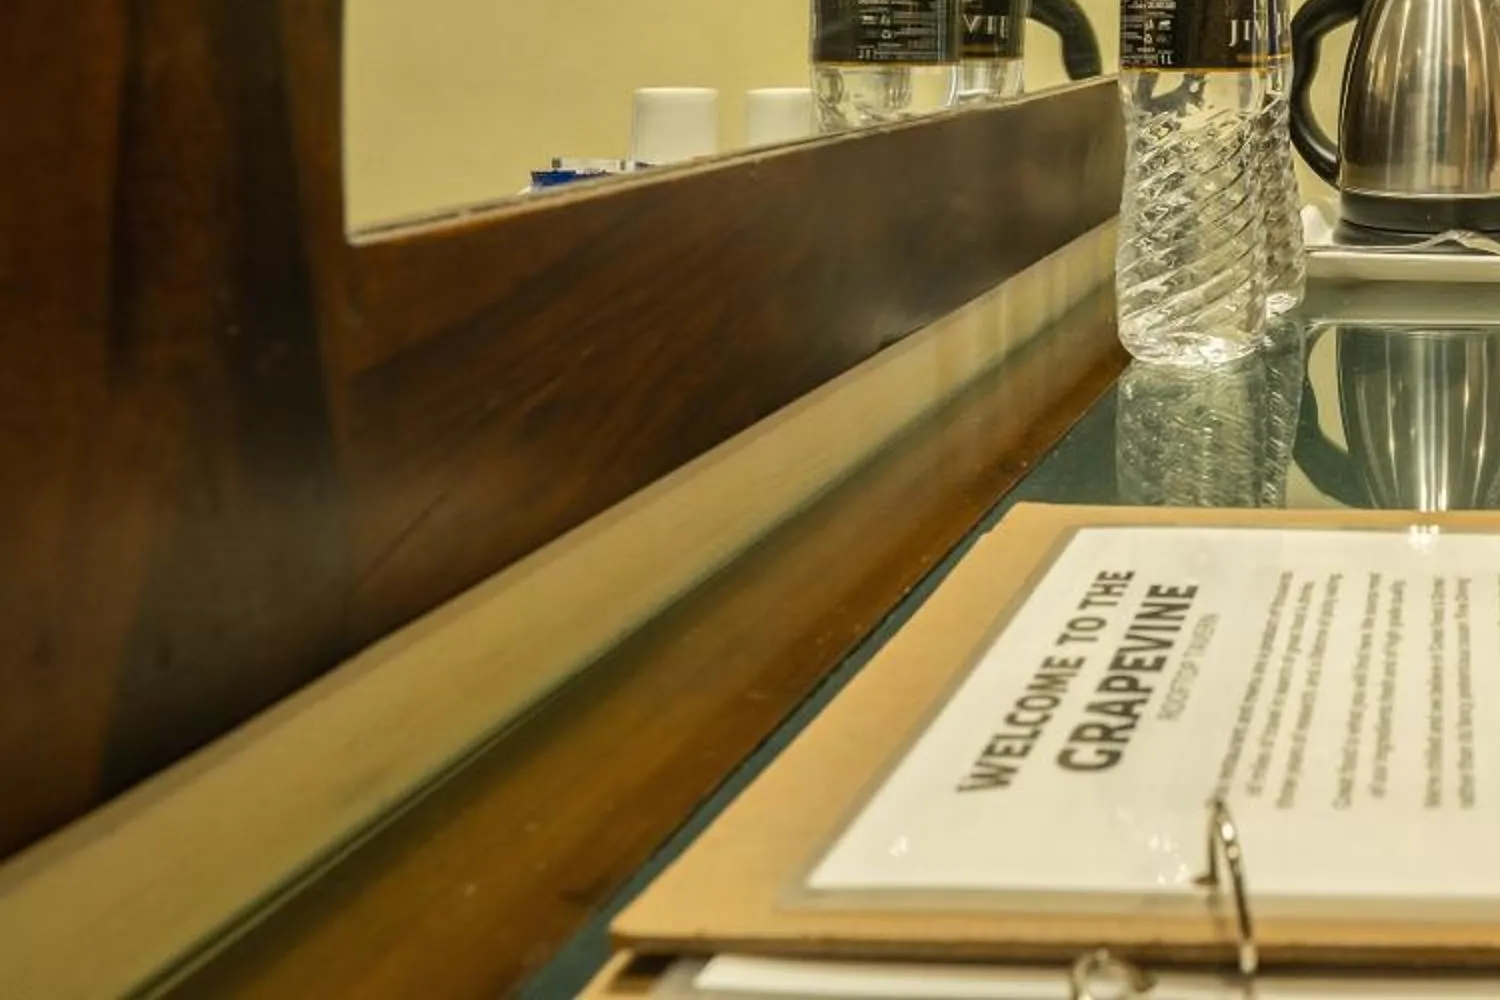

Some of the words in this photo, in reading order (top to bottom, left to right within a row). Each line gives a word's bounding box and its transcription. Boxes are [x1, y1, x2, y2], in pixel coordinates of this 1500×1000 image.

[1055, 616, 1108, 647] TO
[1078, 570, 1135, 610] THE
[1056, 584, 1199, 773] GRAPEVINE
[956, 655, 1086, 793] WELCOME
